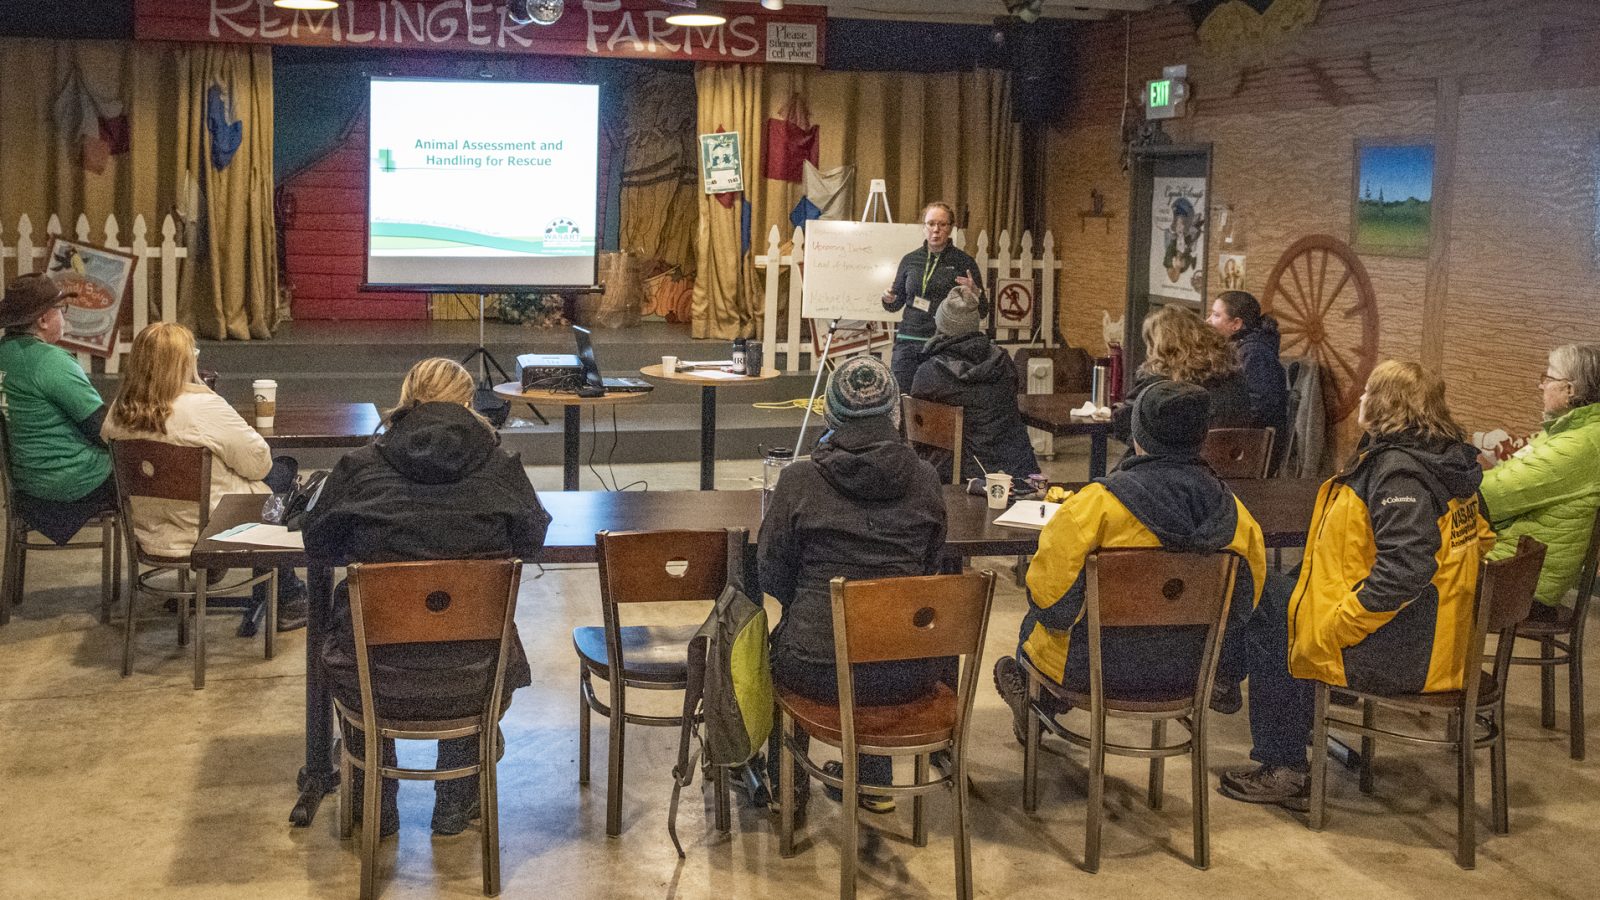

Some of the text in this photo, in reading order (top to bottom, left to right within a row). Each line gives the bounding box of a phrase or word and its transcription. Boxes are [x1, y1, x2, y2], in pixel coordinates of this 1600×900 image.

[582, 0, 760, 57] FARMS
[776, 24, 808, 40] Please
[771, 47, 812, 60] cell phone
[1150, 81, 1170, 108] EXIT
[415, 138, 563, 151] Animal Assessment and
[426, 154, 552, 168] Handling for Rescue
[1387, 495, 1416, 504] Columbia
